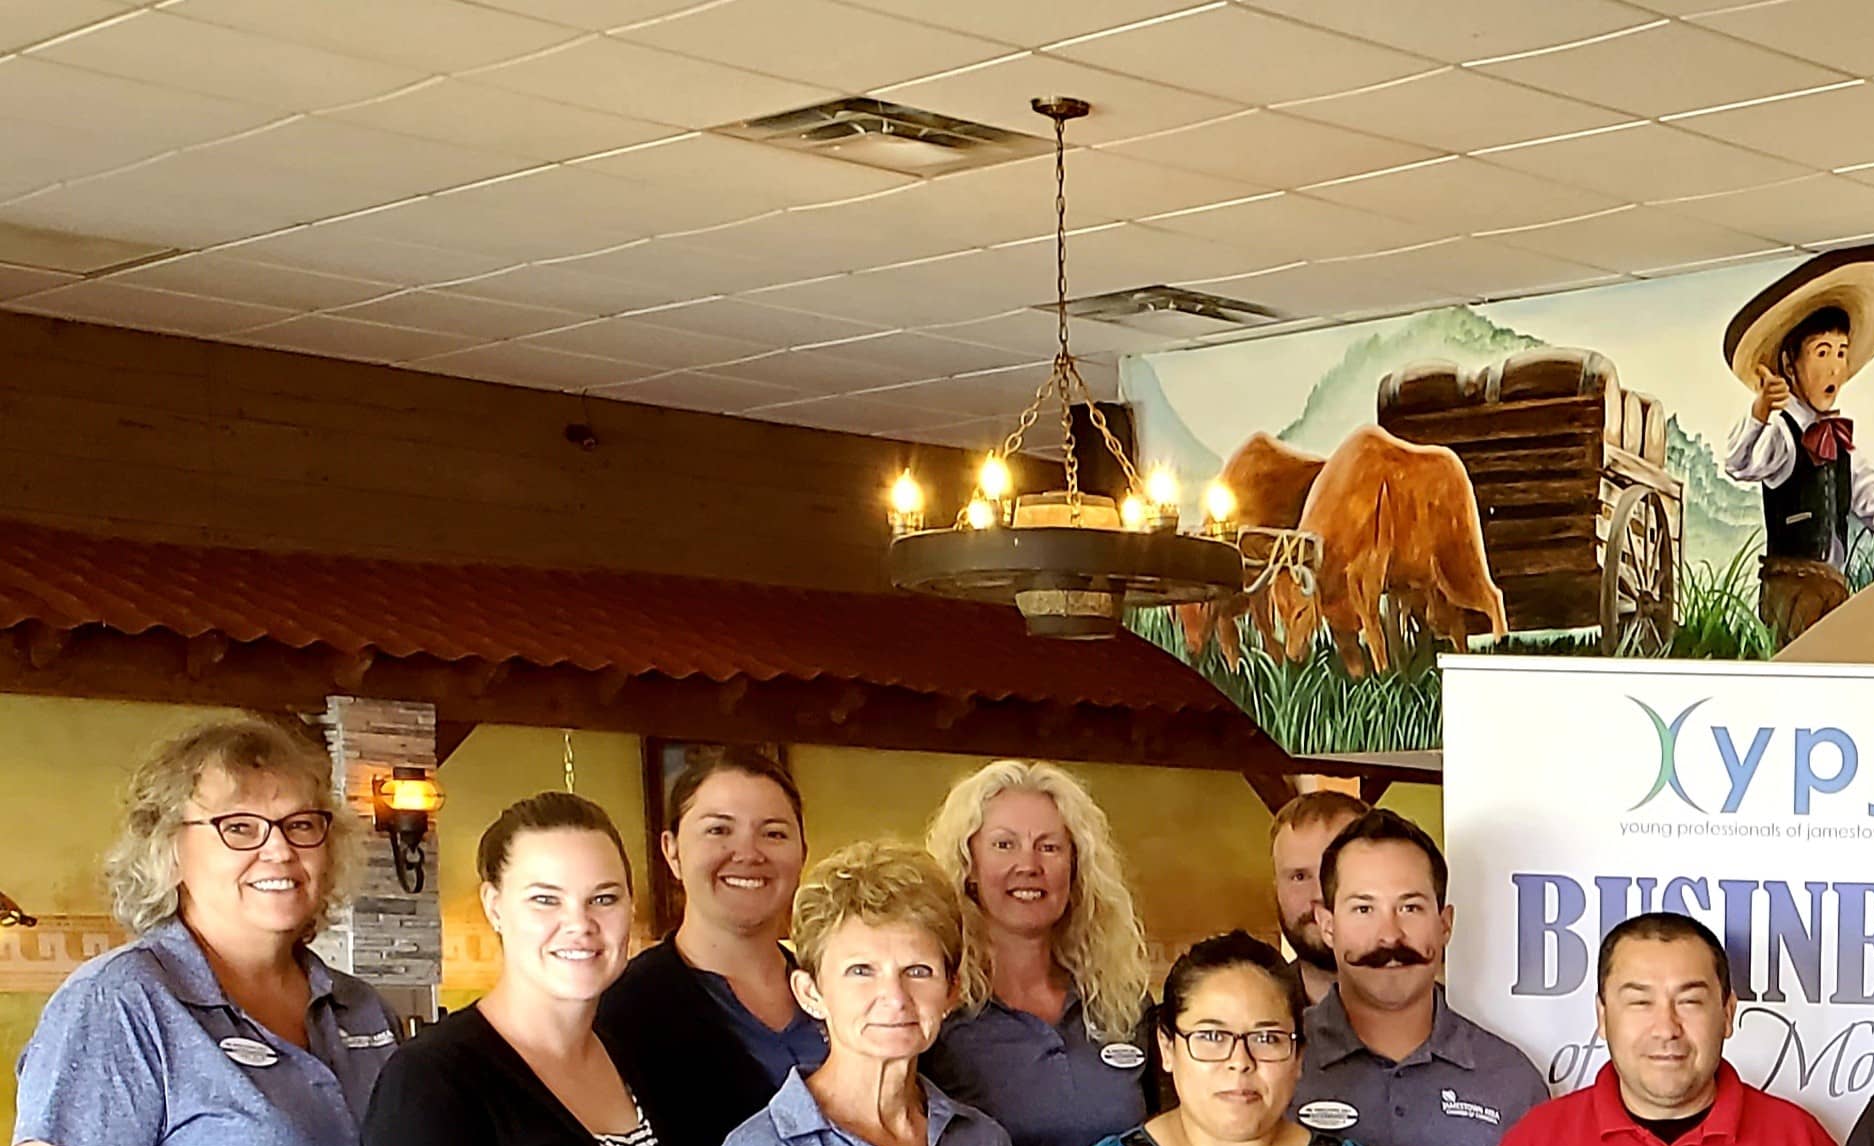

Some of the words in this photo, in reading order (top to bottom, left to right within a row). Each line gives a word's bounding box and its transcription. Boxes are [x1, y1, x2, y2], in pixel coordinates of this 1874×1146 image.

[1619, 820, 1673, 838] young
[1677, 819, 1781, 838] professionals
[1785, 823, 1802, 838] of
